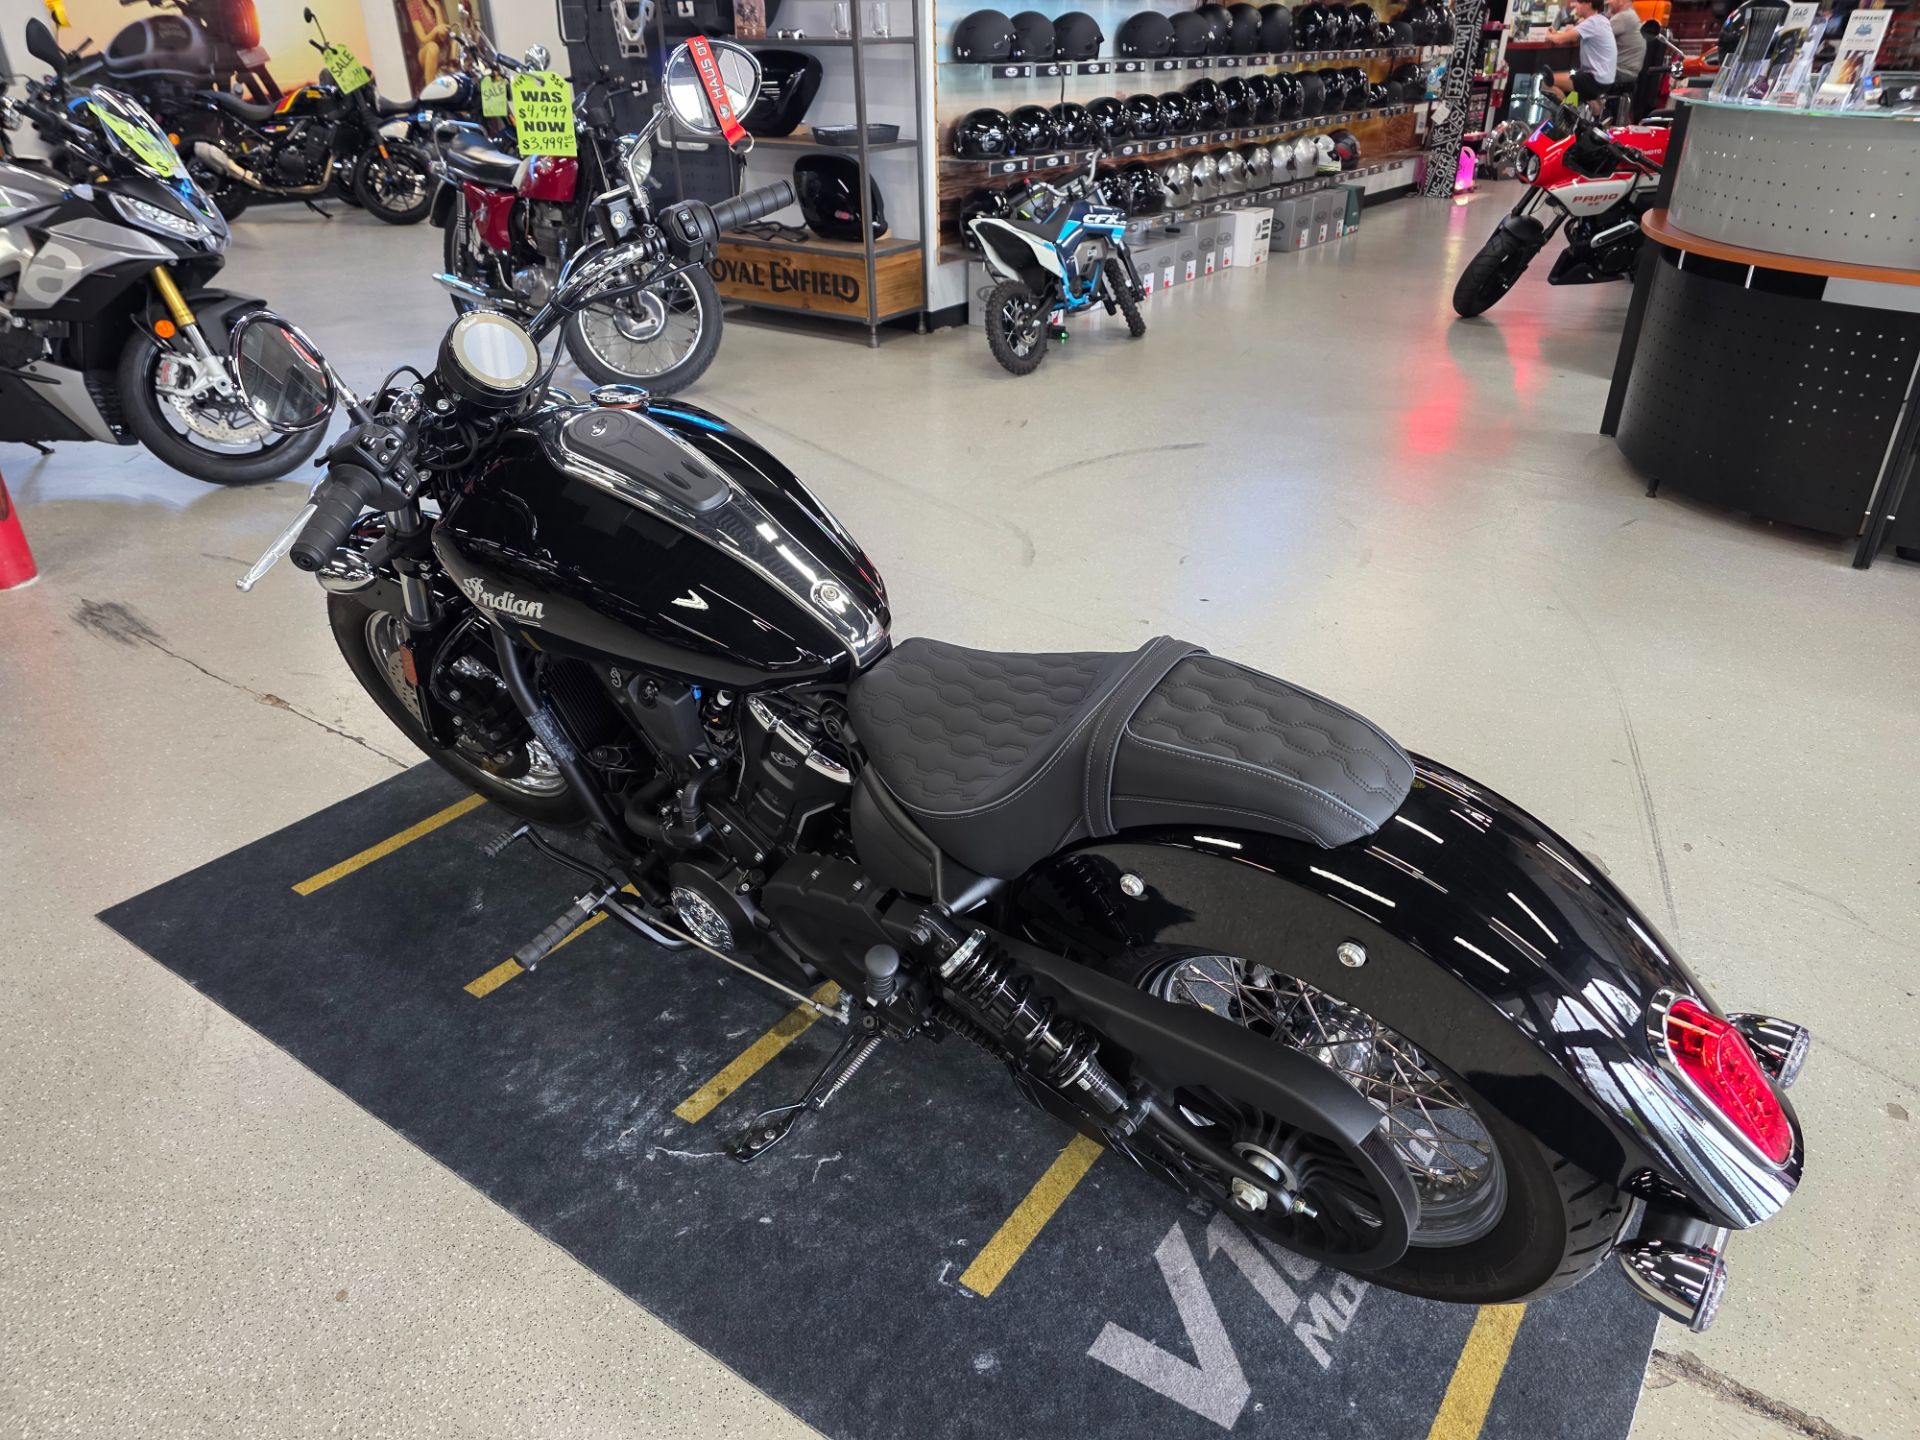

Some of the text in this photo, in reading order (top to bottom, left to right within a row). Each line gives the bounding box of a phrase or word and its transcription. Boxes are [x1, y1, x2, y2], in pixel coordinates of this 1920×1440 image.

[331, 50, 355, 77] SALE
[701, 58, 723, 99] HAUS
[483, 86, 504, 101] SALE
[521, 91, 563, 103] WAS
[518, 105, 567, 119] $4,999
[524, 120, 566, 133] NOW
[1572, 193, 1619, 203] PAPIO
[705, 257, 860, 303] OYAL ENFIELD
[463, 577, 545, 620] Indian
